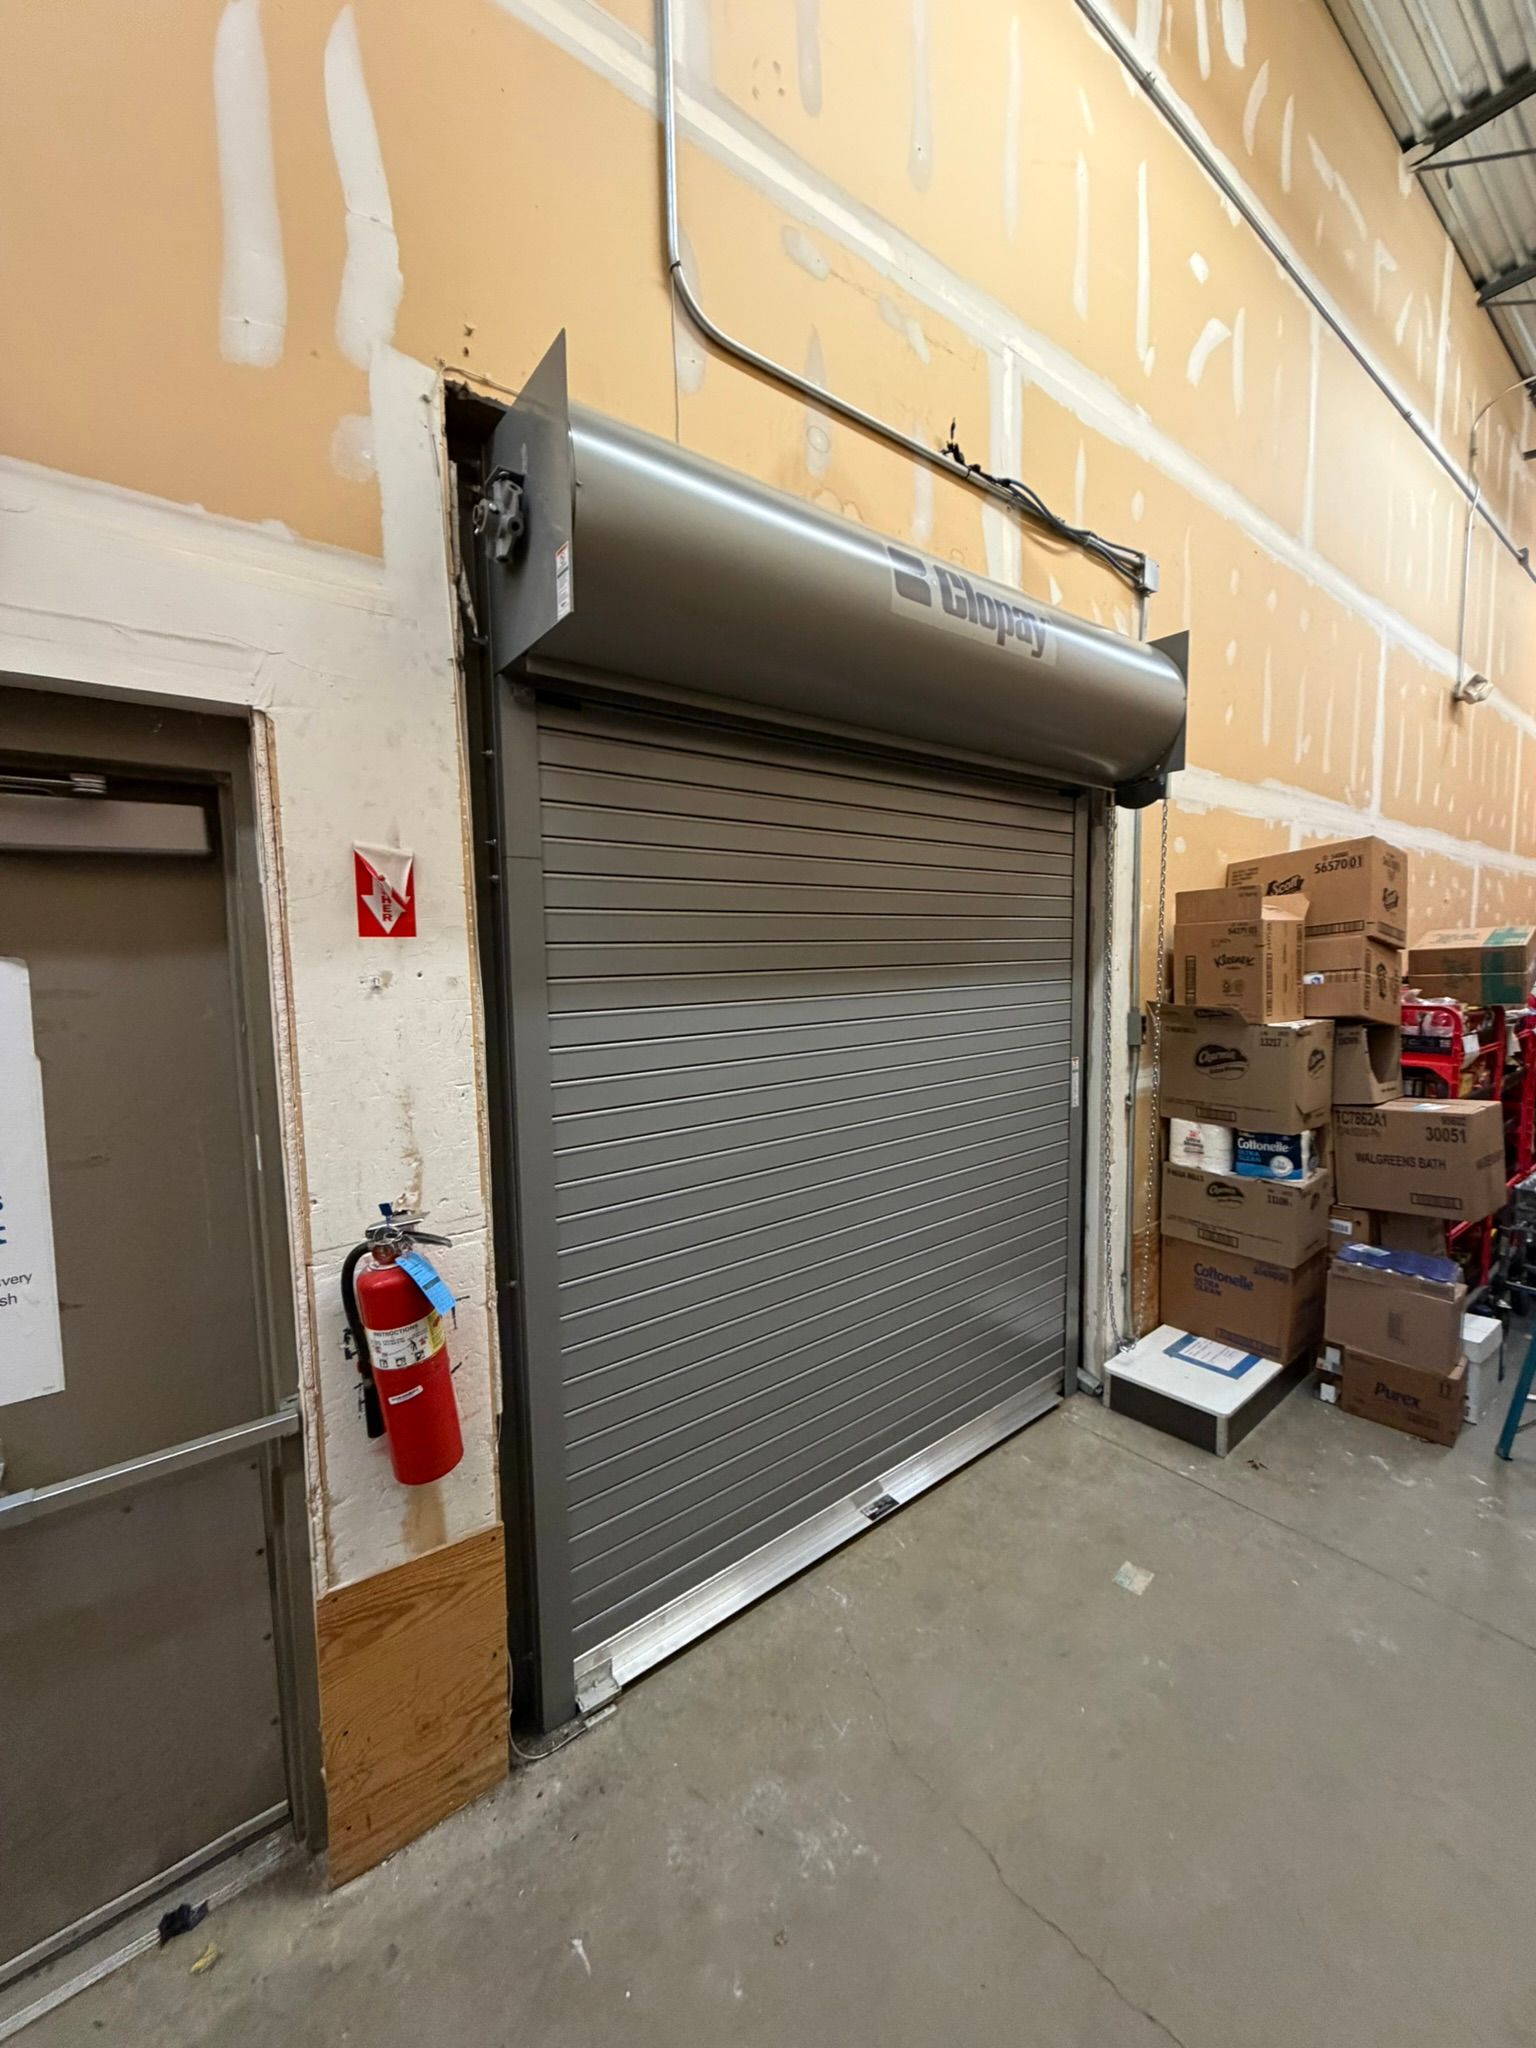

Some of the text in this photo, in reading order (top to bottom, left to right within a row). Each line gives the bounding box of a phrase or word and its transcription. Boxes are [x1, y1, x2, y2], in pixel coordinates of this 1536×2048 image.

[934, 565, 1048, 658] Clopay
[1214, 953, 1255, 969] Kleenex
[1425, 1126, 1467, 1144] 30051
[1237, 1137, 1290, 1153] Cottonelle
[1355, 1152, 1447, 1171] WALGREENS BATH
[0, 1272, 33, 1286] very
[1194, 1262, 1254, 1291] Cottonelle
[1374, 1382, 1421, 1408] Purex
